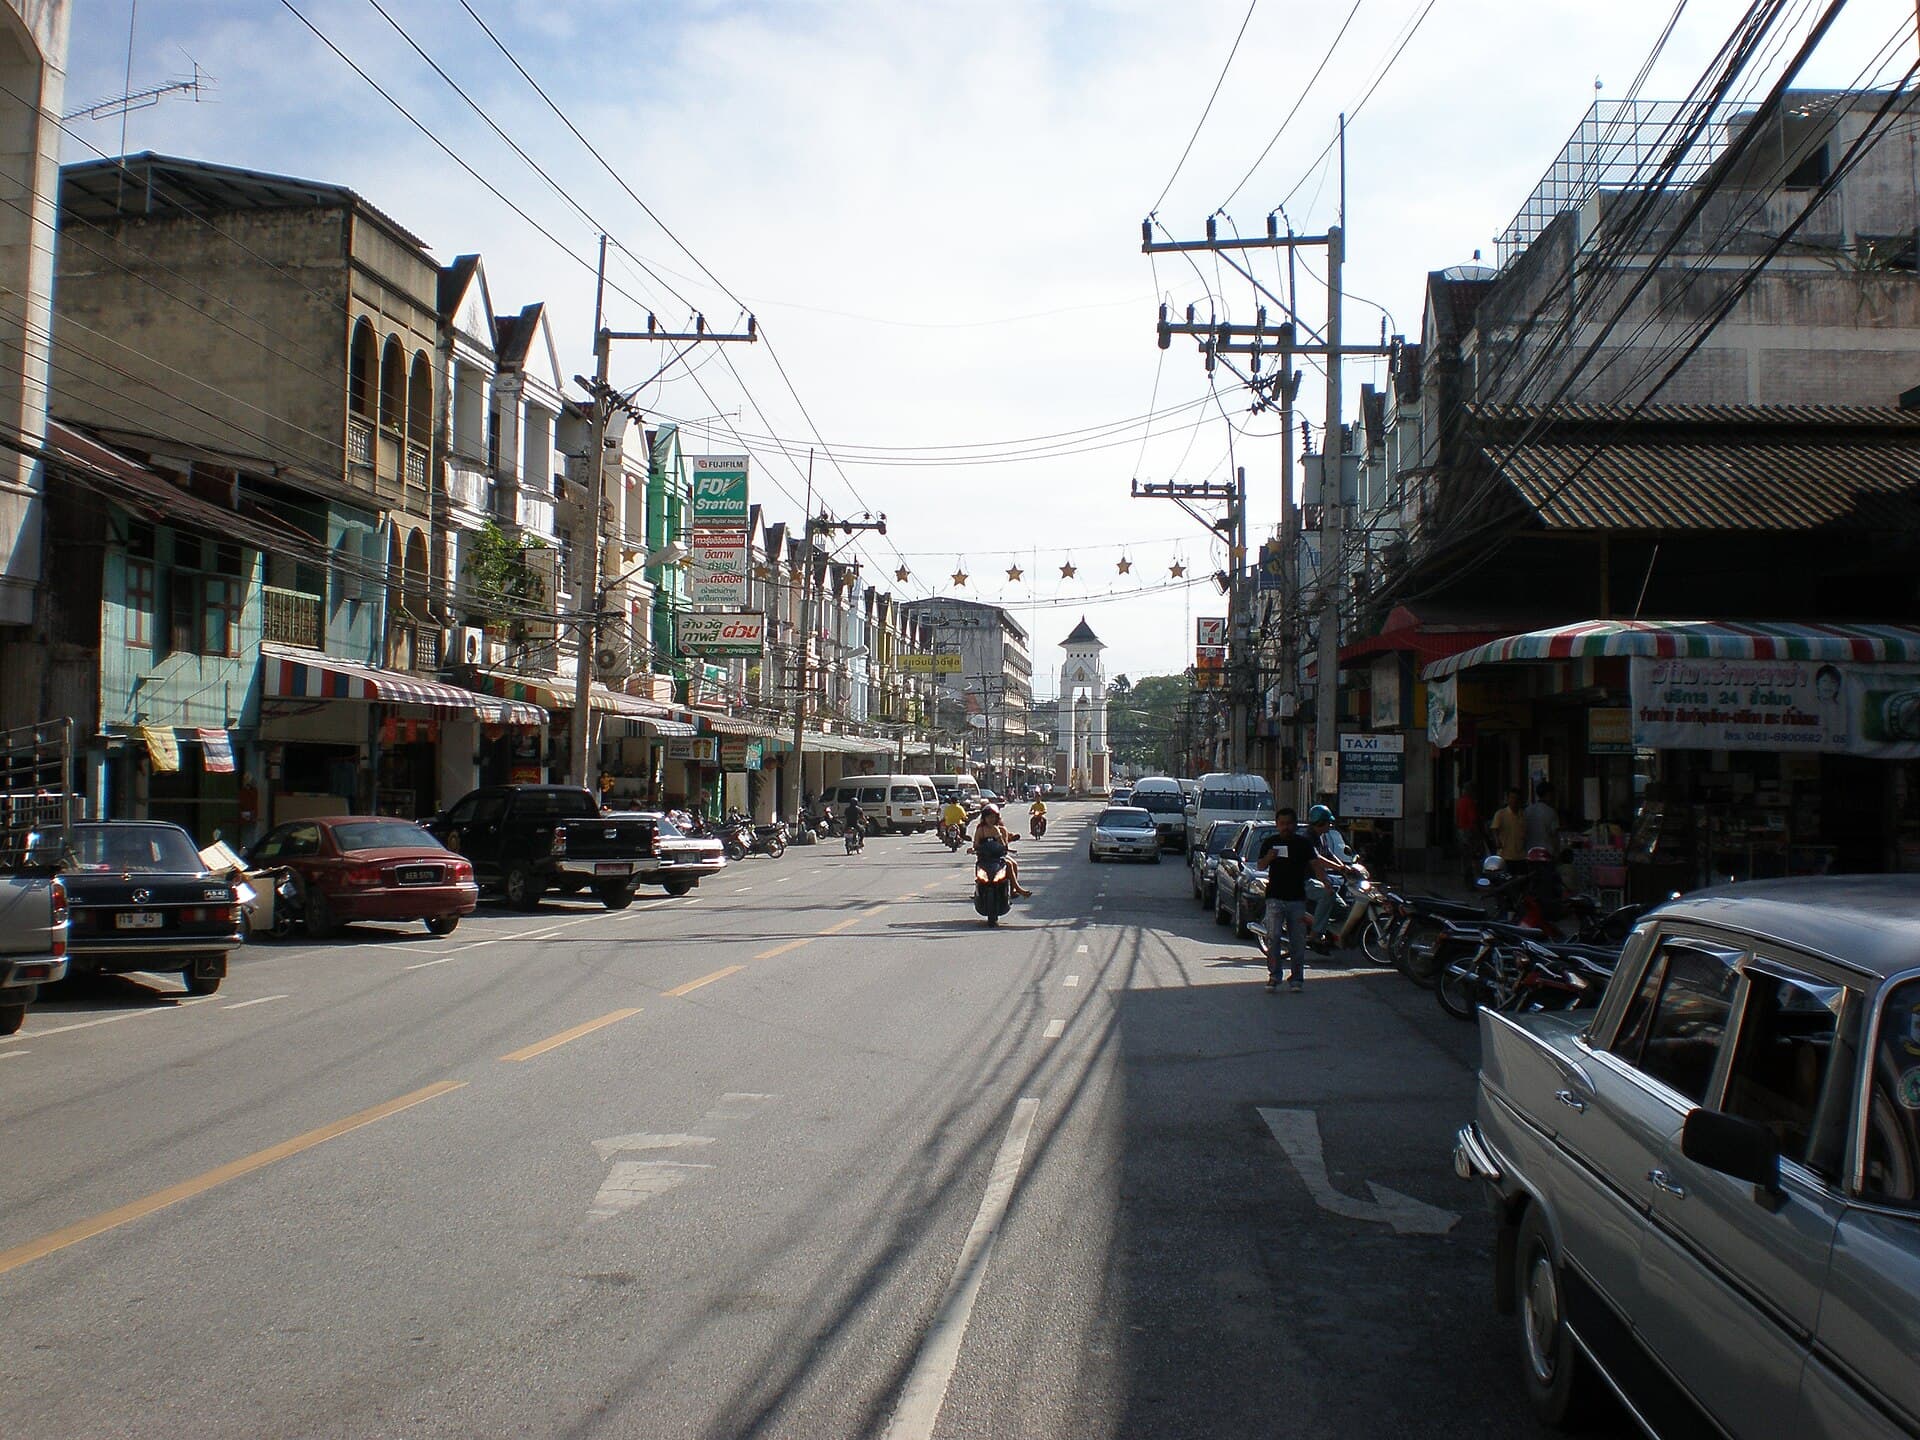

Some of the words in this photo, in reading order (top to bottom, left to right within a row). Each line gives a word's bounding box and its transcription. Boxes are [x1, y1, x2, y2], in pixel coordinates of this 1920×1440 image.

[708, 461, 743, 469] FUJIFILM
[696, 498, 744, 511] Station
[704, 618, 723, 630] อัด
[722, 621, 760, 639] ด่วน
[682, 629, 721, 642] ภาพสี
[1203, 621, 1220, 644] 7
[1719, 691, 1738, 705] 24
[1345, 739, 1377, 749] TAXI
